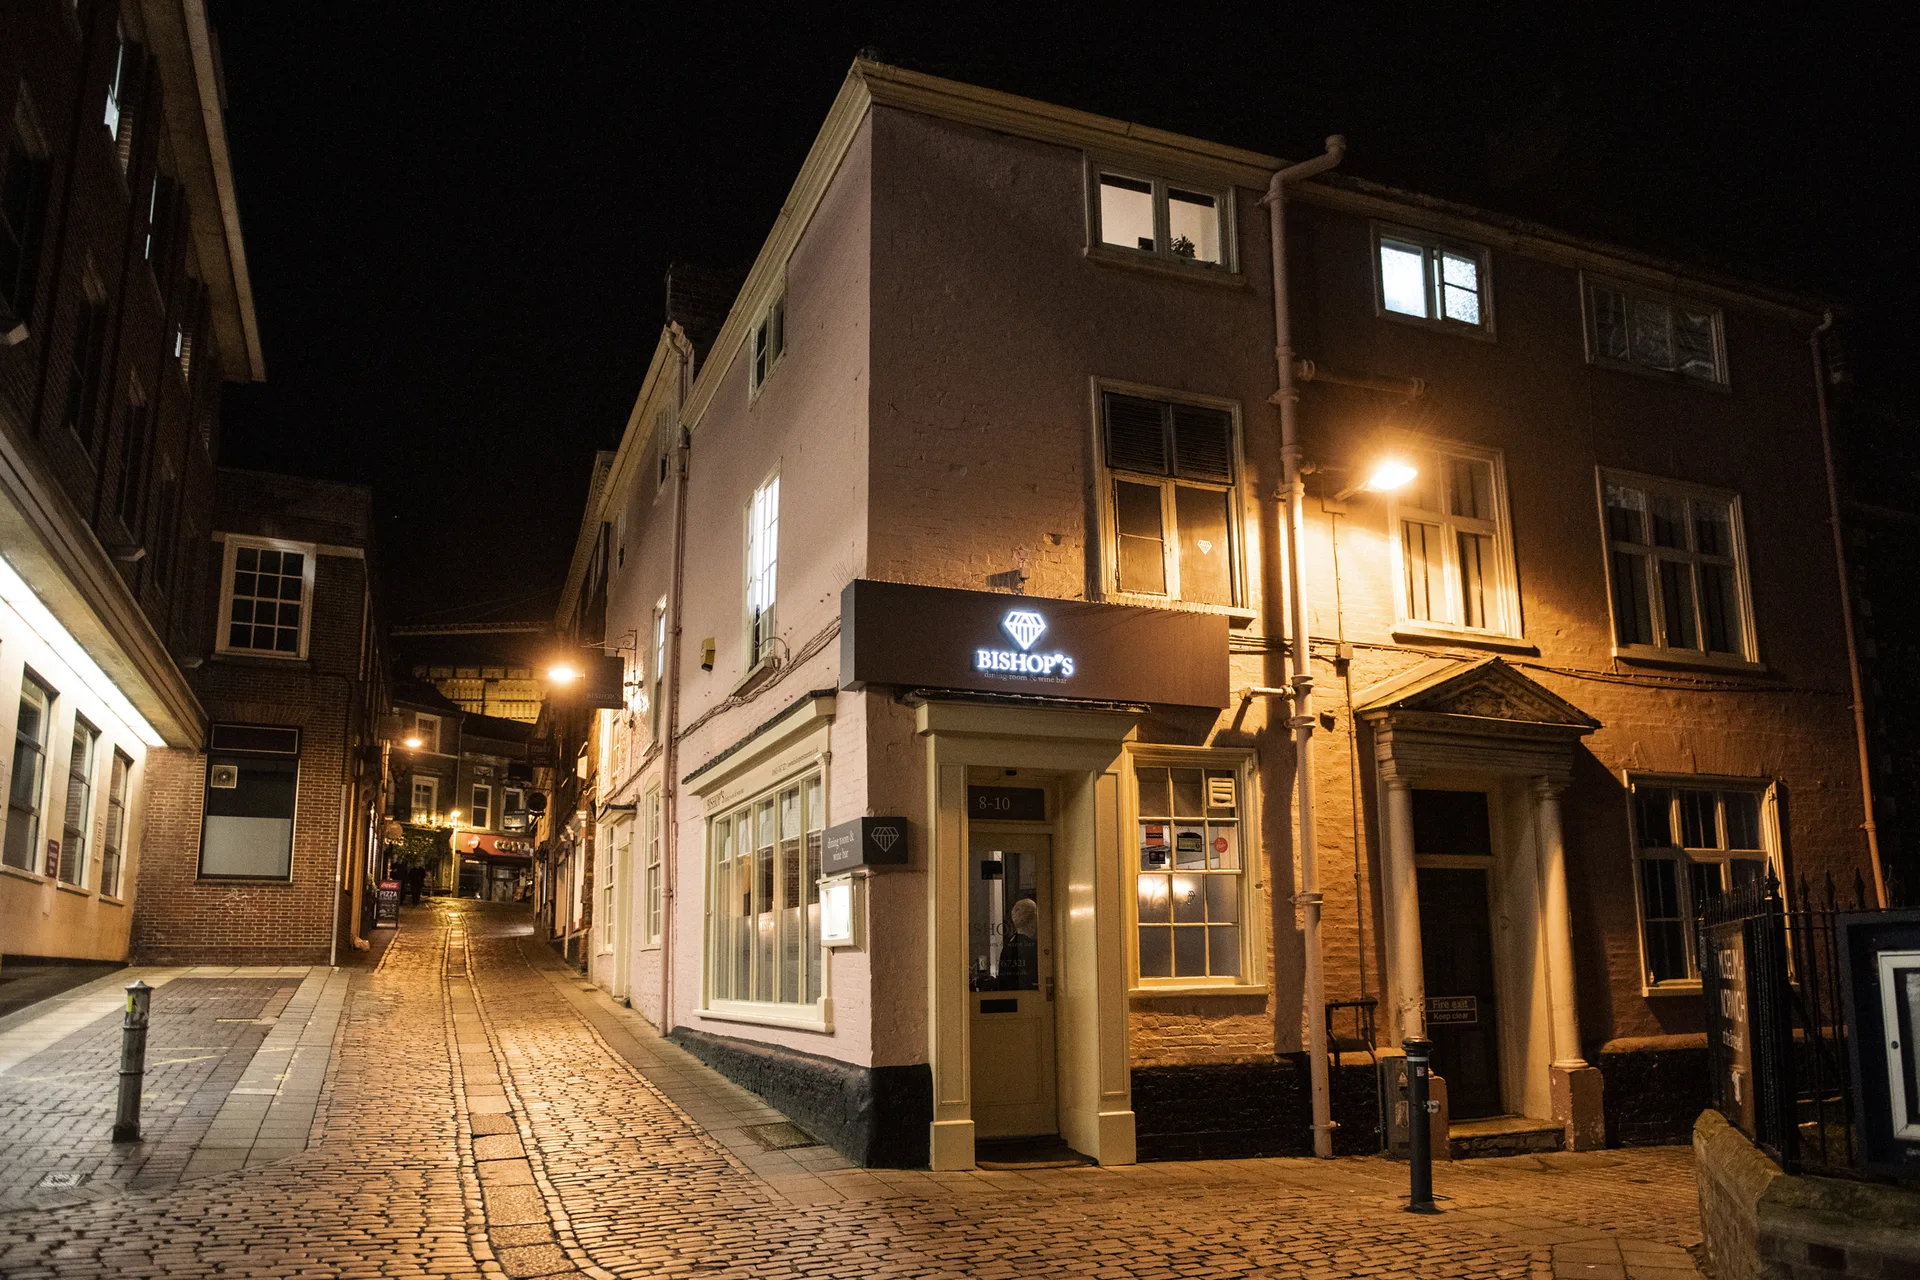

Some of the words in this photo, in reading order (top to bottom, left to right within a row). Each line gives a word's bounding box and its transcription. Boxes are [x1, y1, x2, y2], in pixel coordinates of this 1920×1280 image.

[977, 650, 1074, 675] BISHOP'S
[984, 671, 1007, 681] dining
[1029, 674, 1037, 682] &
[1056, 676, 1067, 684] bar
[979, 796, 1010, 810] 8-10
[1432, 1000, 1450, 1009] Fire
[1451, 1000, 1469, 1008] exit
[1433, 1013, 1451, 1021] Keep
